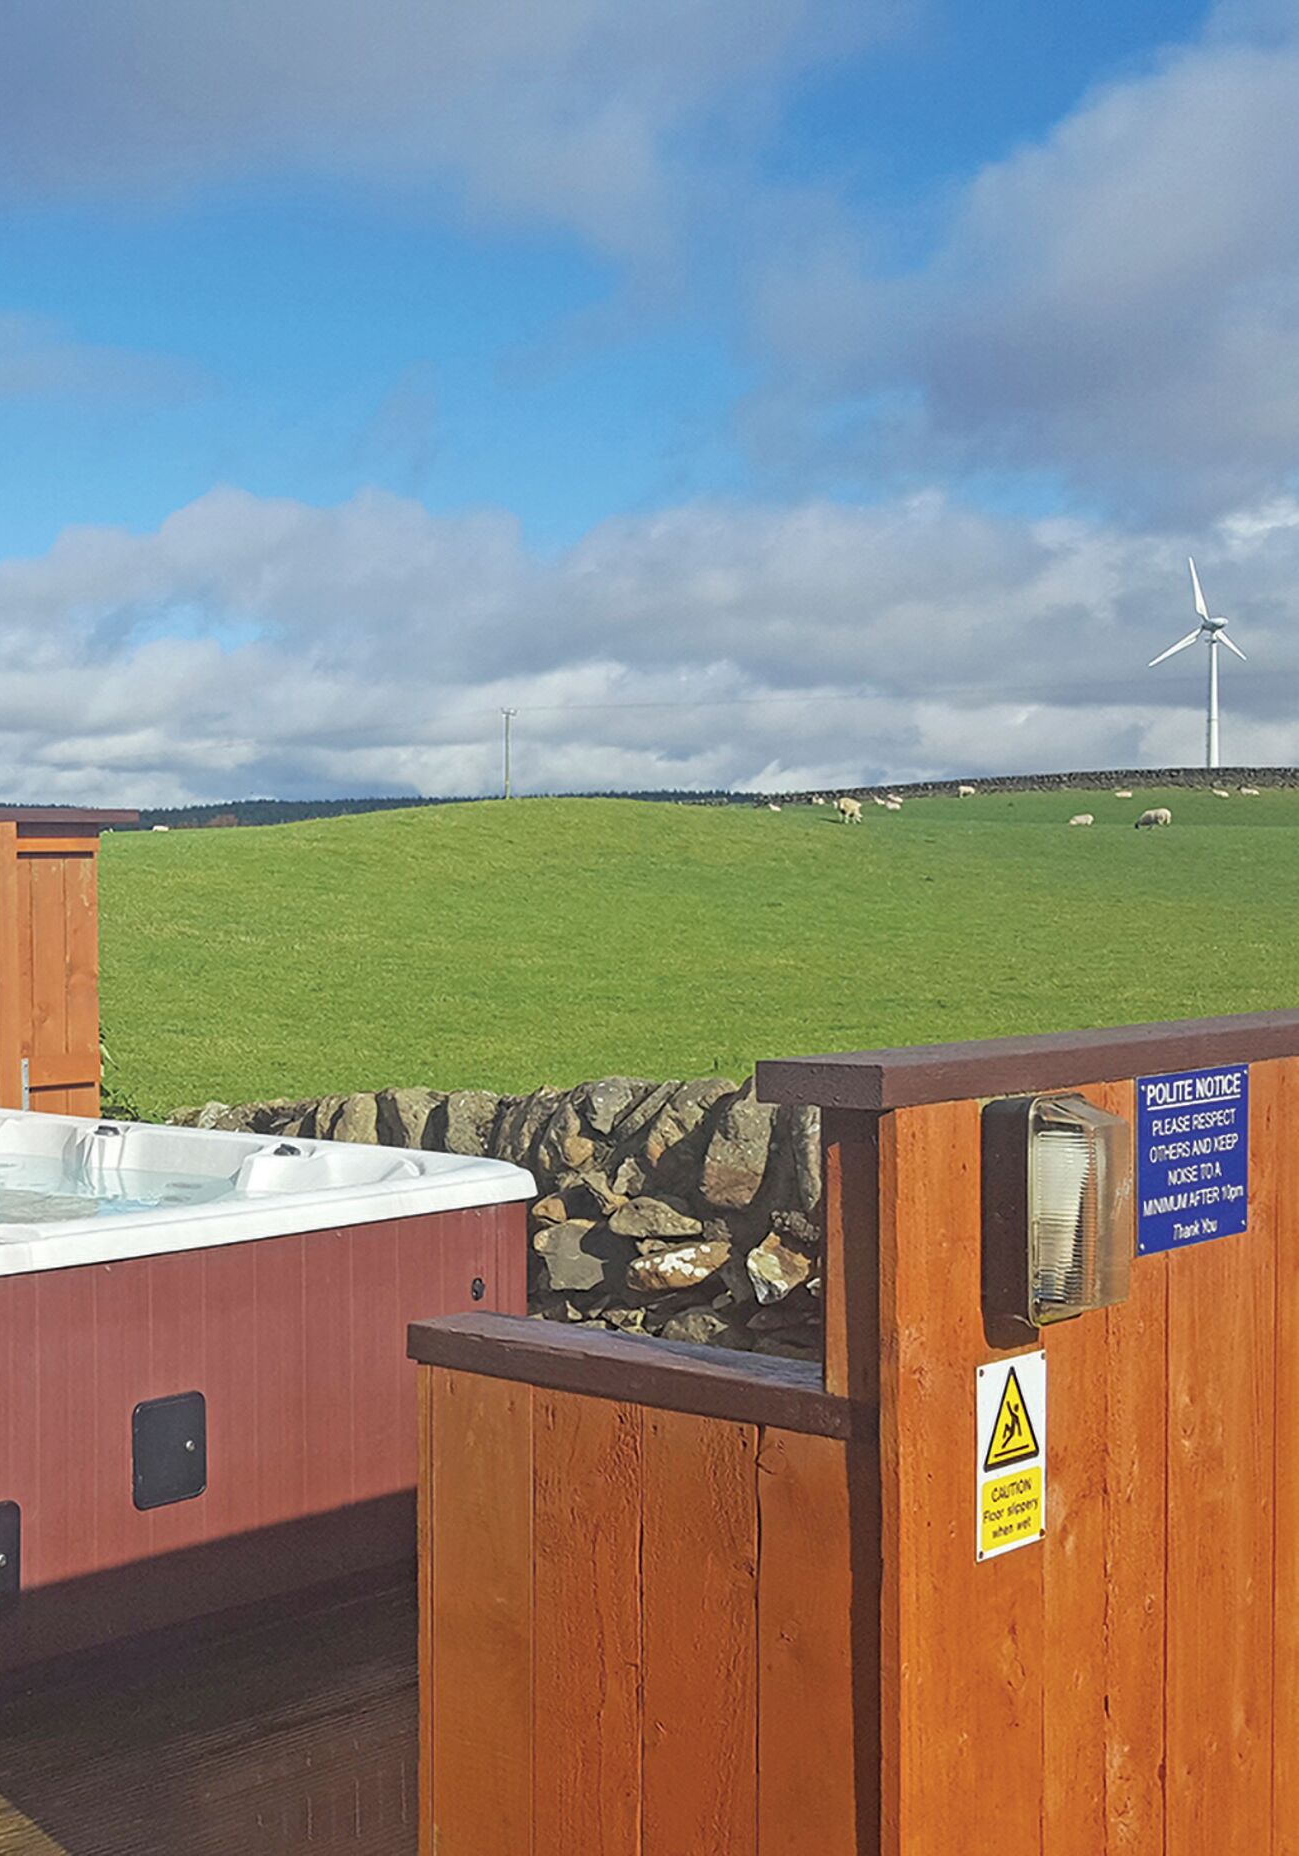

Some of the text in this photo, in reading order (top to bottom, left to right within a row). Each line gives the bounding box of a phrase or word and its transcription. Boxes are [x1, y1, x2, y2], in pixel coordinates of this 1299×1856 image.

[1146, 1073, 1241, 1106] POLITE NOTICE
[1152, 1108, 1237, 1136] PLEASE RESPECT
[1149, 1133, 1239, 1164] OTHERS AND KEEP
[1167, 1161, 1222, 1186] NOISE TO A
[1143, 1184, 1244, 1217] MINIMUM AFTER 10pm
[1172, 1217, 1218, 1241] Thank You
[991, 1477, 1032, 1503] CAUTION
[982, 1496, 1039, 1524] Floor slippery
[992, 1516, 1031, 1539] when wet
